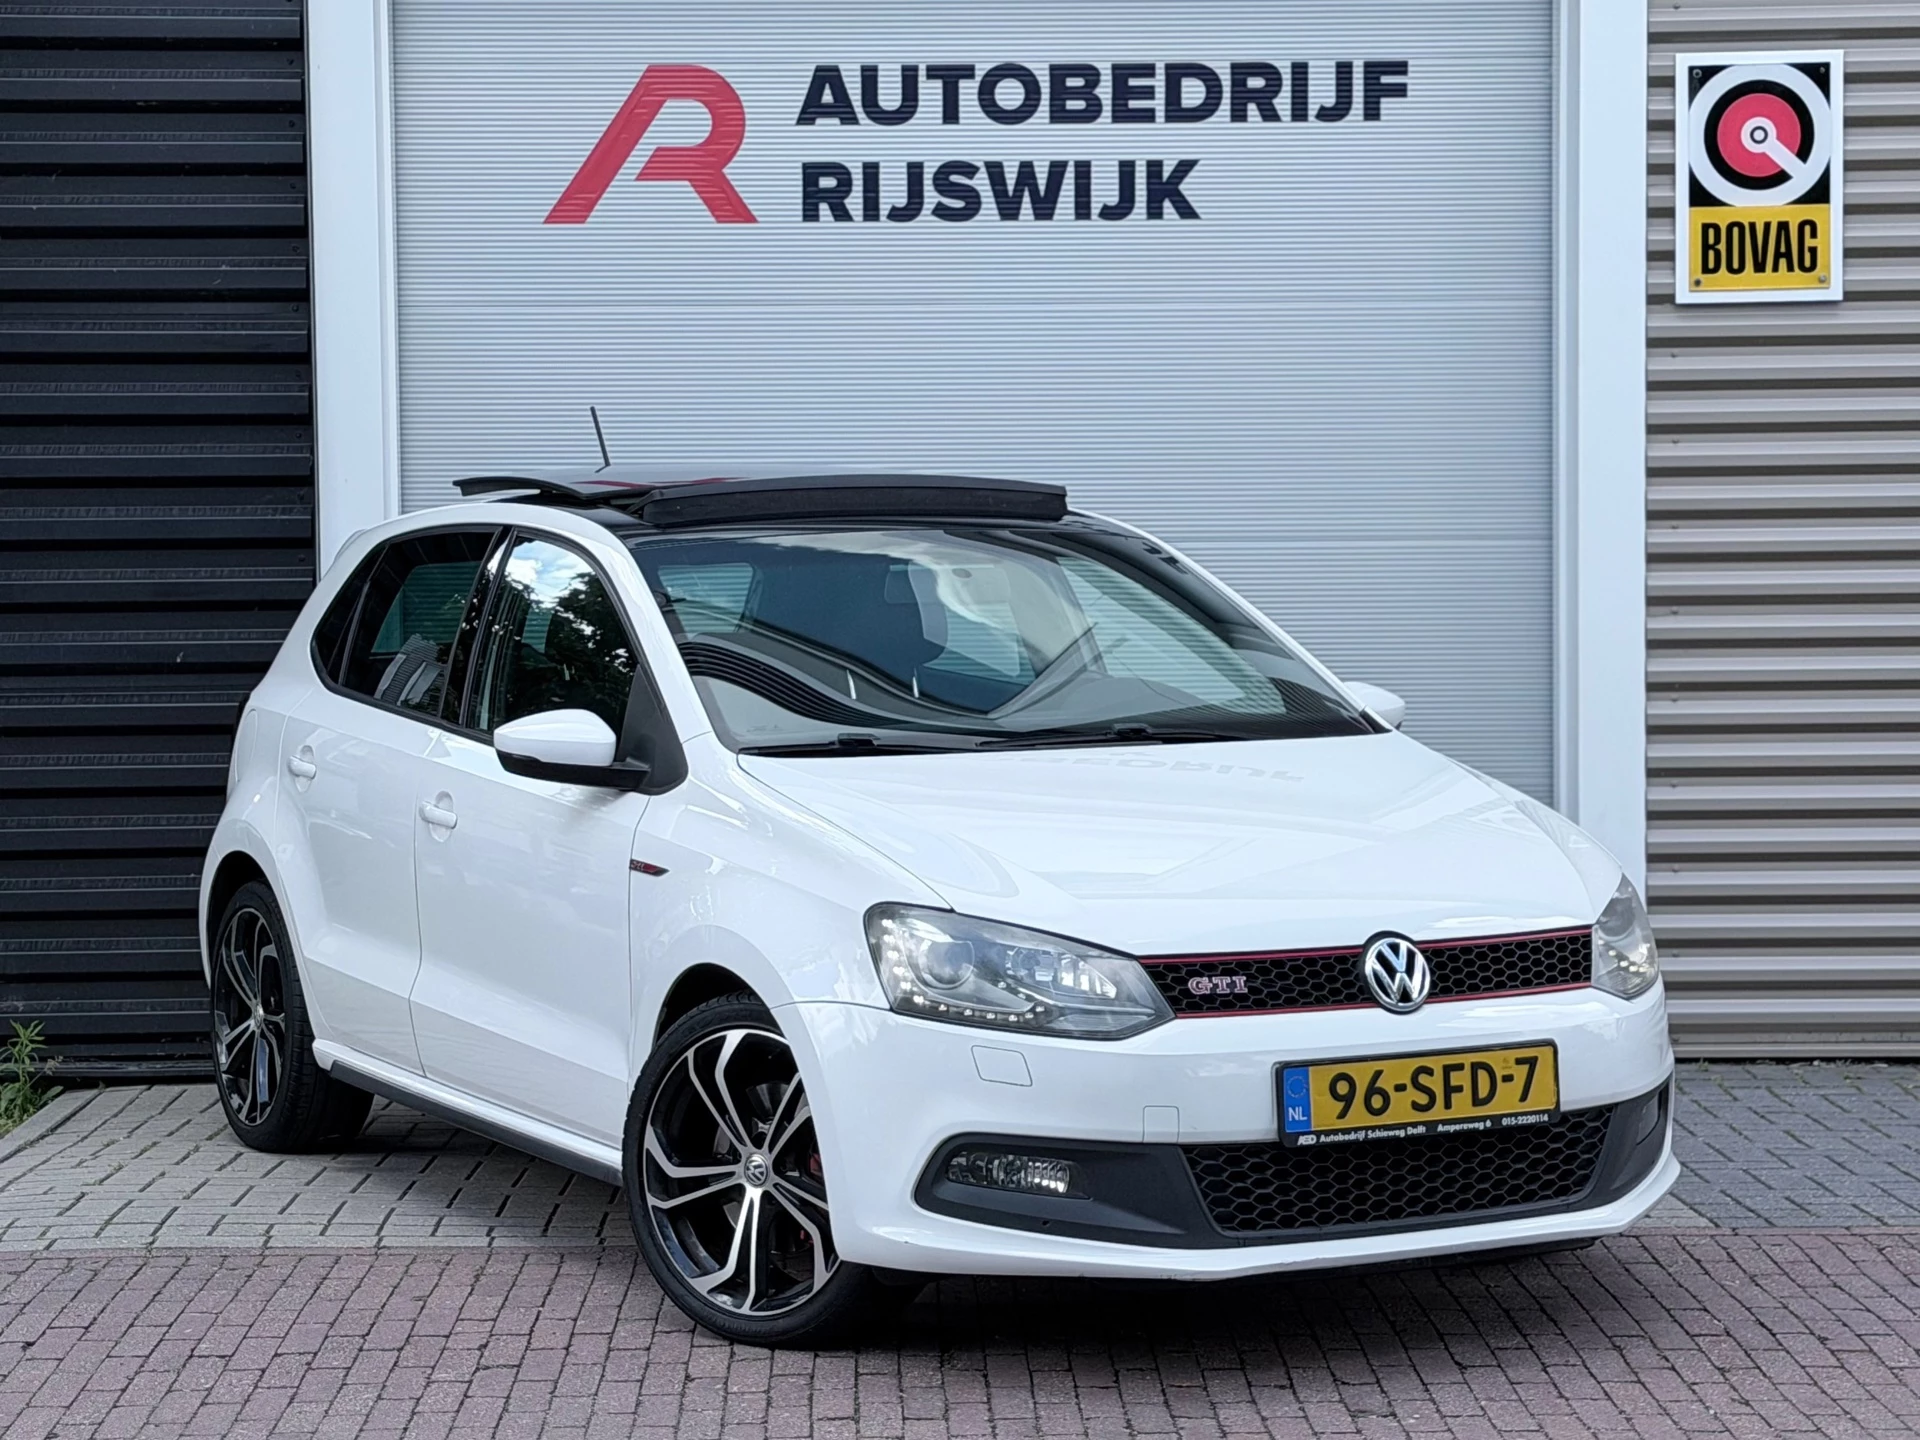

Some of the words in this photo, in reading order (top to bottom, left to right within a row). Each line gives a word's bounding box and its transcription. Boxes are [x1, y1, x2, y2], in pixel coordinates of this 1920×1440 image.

[797, 60, 1409, 126] AUTOBEDRIJF
[801, 160, 1202, 224] RIJSWIJK
[1701, 219, 1818, 275] BOVAG
[1188, 976, 1248, 995] GTI
[1288, 1106, 1307, 1121] NL
[1328, 1056, 1539, 1120] 96-SFD-7
[1319, 1130, 1366, 1142] Autobedrijf
[1367, 1126, 1406, 1138] Schieweg
[1407, 1125, 1426, 1135] Delft
[1437, 1120, 1485, 1133] Ampereweg
[1485, 1119, 1492, 1128] 6
[1501, 1113, 1549, 1126] 015-2220114
